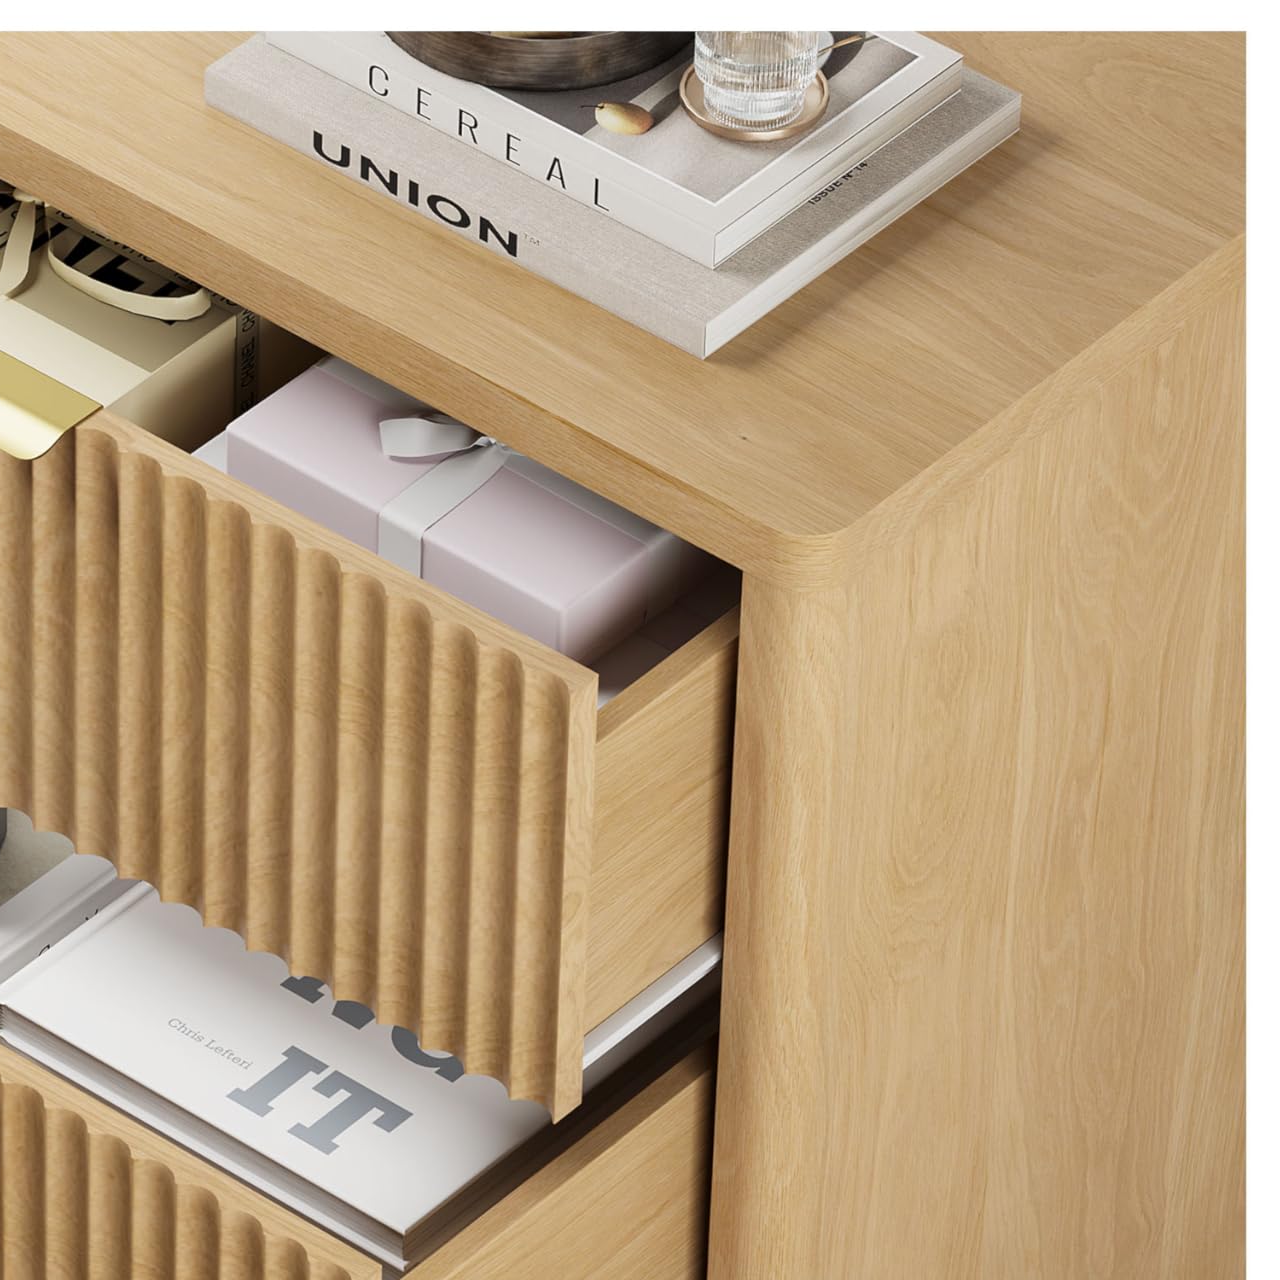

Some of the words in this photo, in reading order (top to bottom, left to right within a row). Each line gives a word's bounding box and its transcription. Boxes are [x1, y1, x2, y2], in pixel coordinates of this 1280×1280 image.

[312, 129, 518, 258] UNION
[368, 64, 610, 213] CEREAL
[808, 181, 843, 205] ISSUE
[167, 1017, 206, 1043] Chris
[204, 1039, 255, 1071] Lefteri
[225, 1044, 415, 1157] IT
